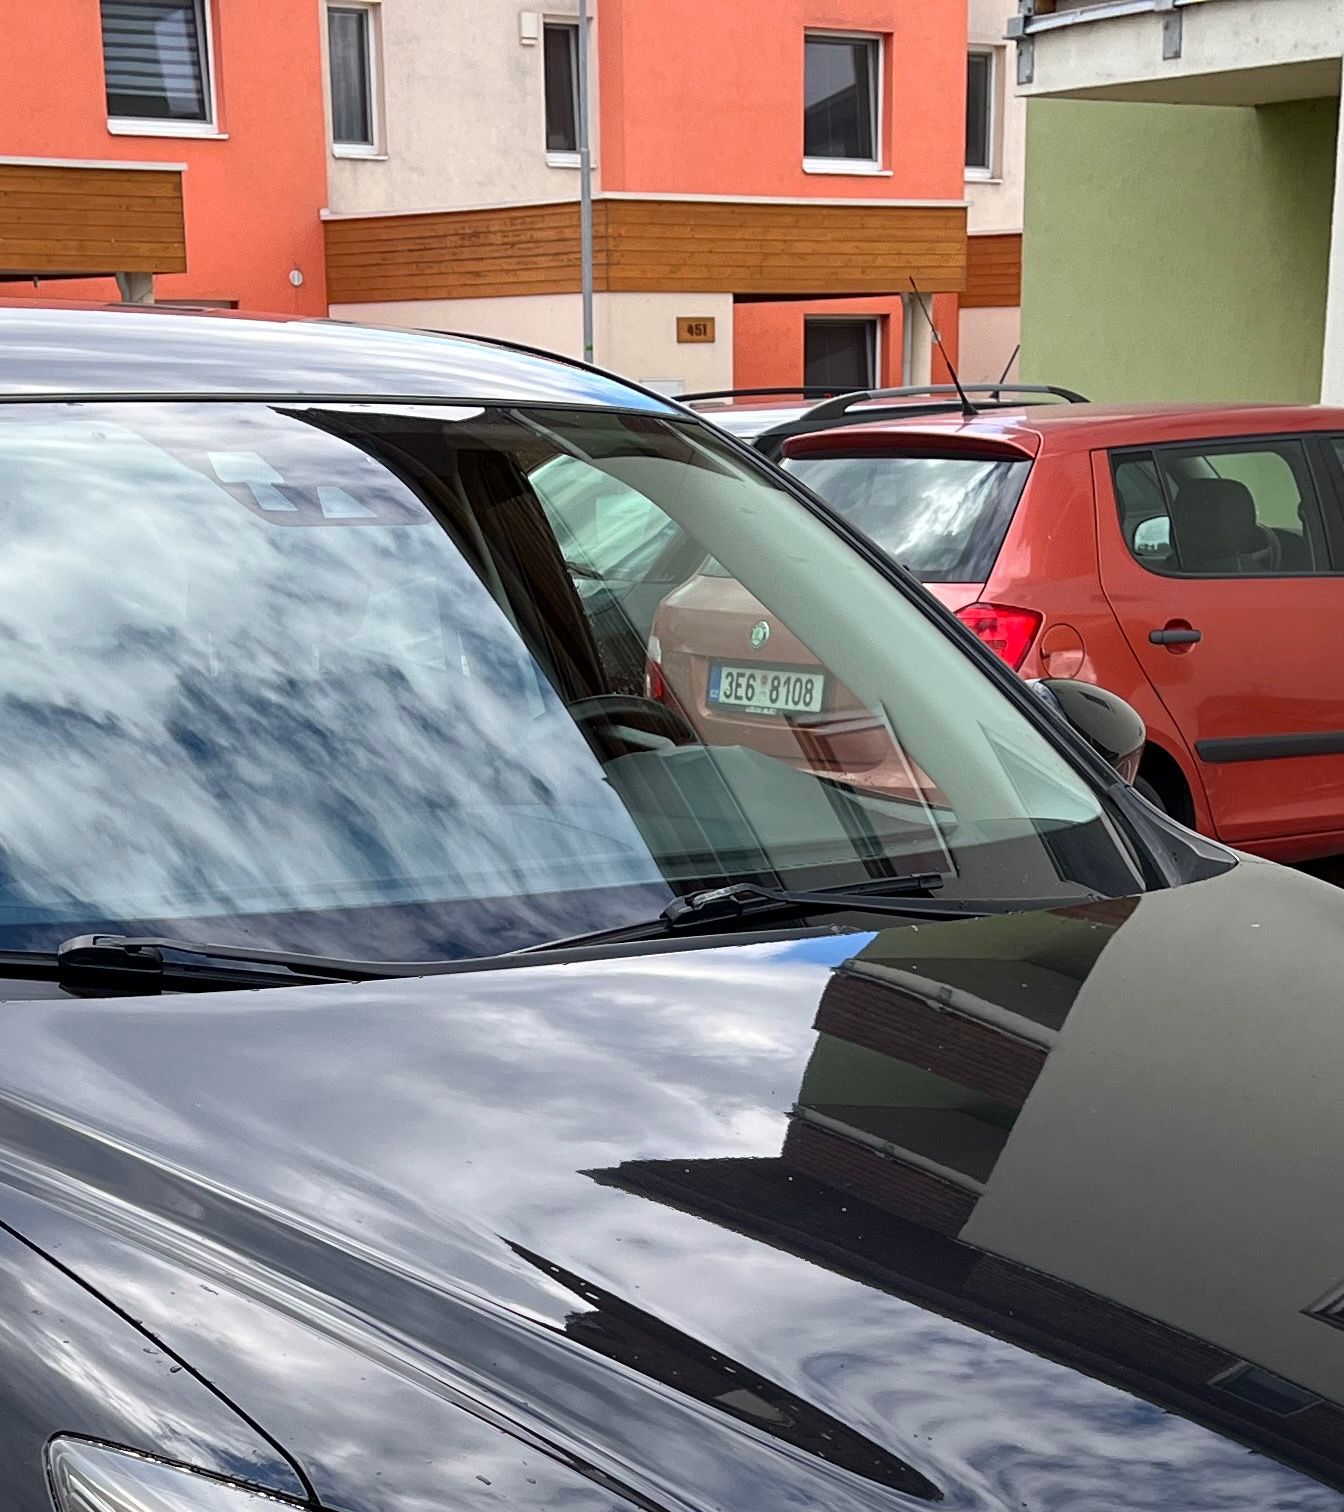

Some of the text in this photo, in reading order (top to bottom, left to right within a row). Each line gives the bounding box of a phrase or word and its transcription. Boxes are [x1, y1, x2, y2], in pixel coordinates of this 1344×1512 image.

[687, 323, 708, 337] 451
[723, 671, 814, 708] 3E6 8108
